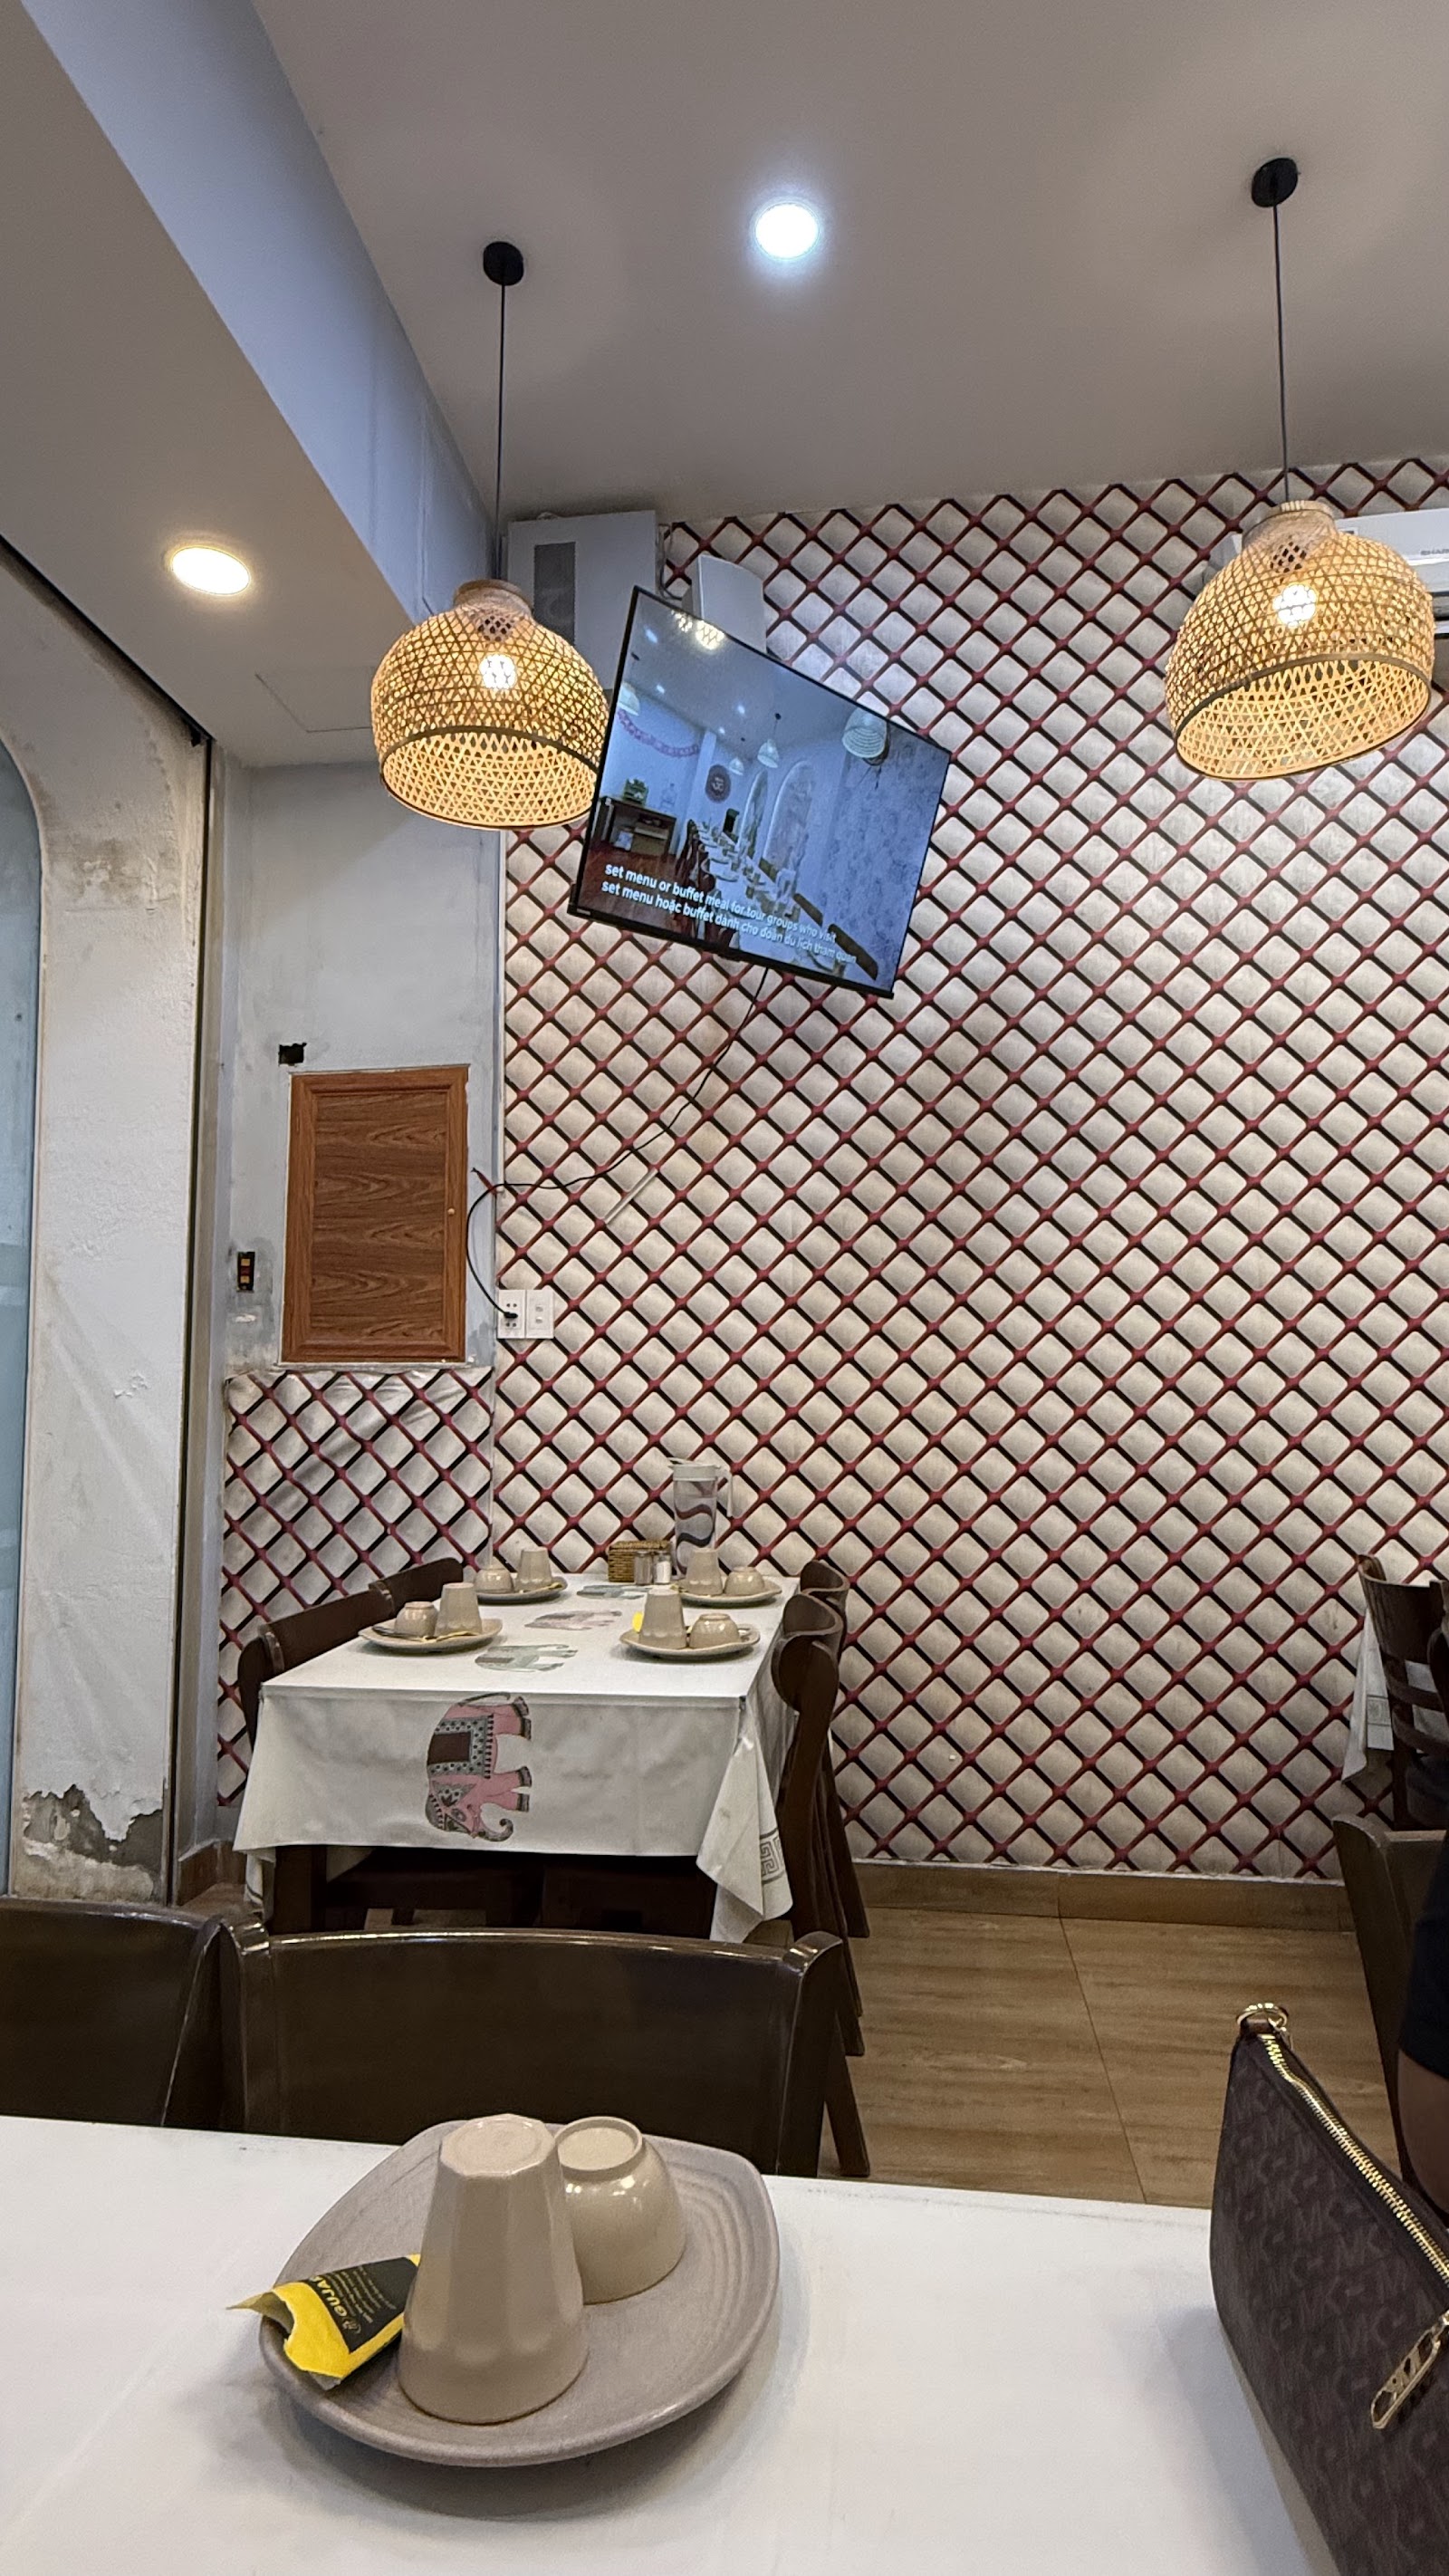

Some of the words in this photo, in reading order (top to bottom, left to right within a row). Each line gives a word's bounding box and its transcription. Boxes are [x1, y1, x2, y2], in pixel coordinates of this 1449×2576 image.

[601, 880, 620, 895] set
[622, 887, 654, 905] menu
[655, 894, 682, 914] hoặc
[683, 902, 714, 922] buffet
[741, 922, 758, 936] cho
[784, 934, 796, 947] du
[814, 942, 835, 957] tham
[836, 951, 857, 964] quan
[605, 863, 624, 878] set
[625, 870, 657, 889] menu
[658, 880, 672, 892] or
[672, 882, 705, 903] buffet
[705, 894, 729, 911] meal
[730, 901, 745, 915] for
[746, 907, 765, 921] tour
[767, 914, 799, 931] groups
[800, 923, 817, 937] who
[819, 929, 837, 943] visit
